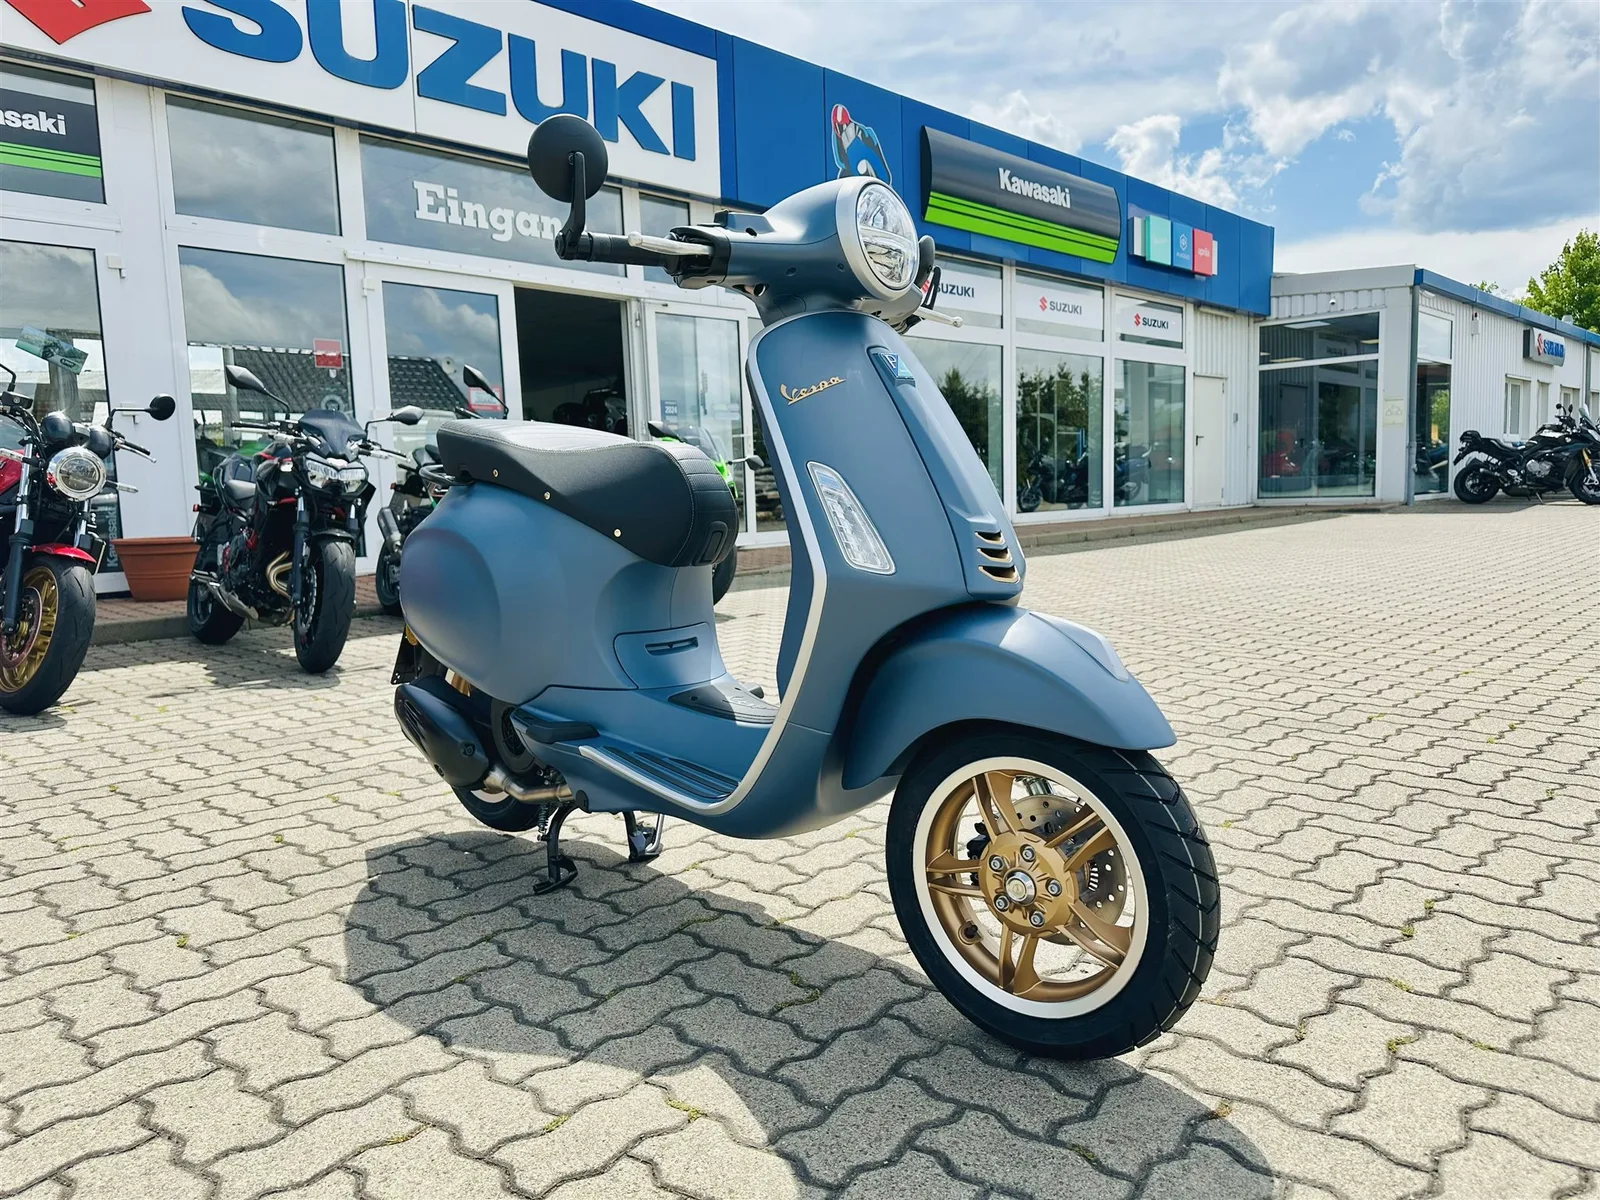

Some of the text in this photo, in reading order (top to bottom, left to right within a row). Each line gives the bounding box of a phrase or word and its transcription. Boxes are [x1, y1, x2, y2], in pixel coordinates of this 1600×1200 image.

[998, 167, 1071, 209] Kawasaki
[413, 180, 563, 242] Eingan
[1049, 301, 1082, 315] SUZUKI
[1142, 317, 1169, 330] SUZUKI
[780, 376, 847, 406] Vespa
